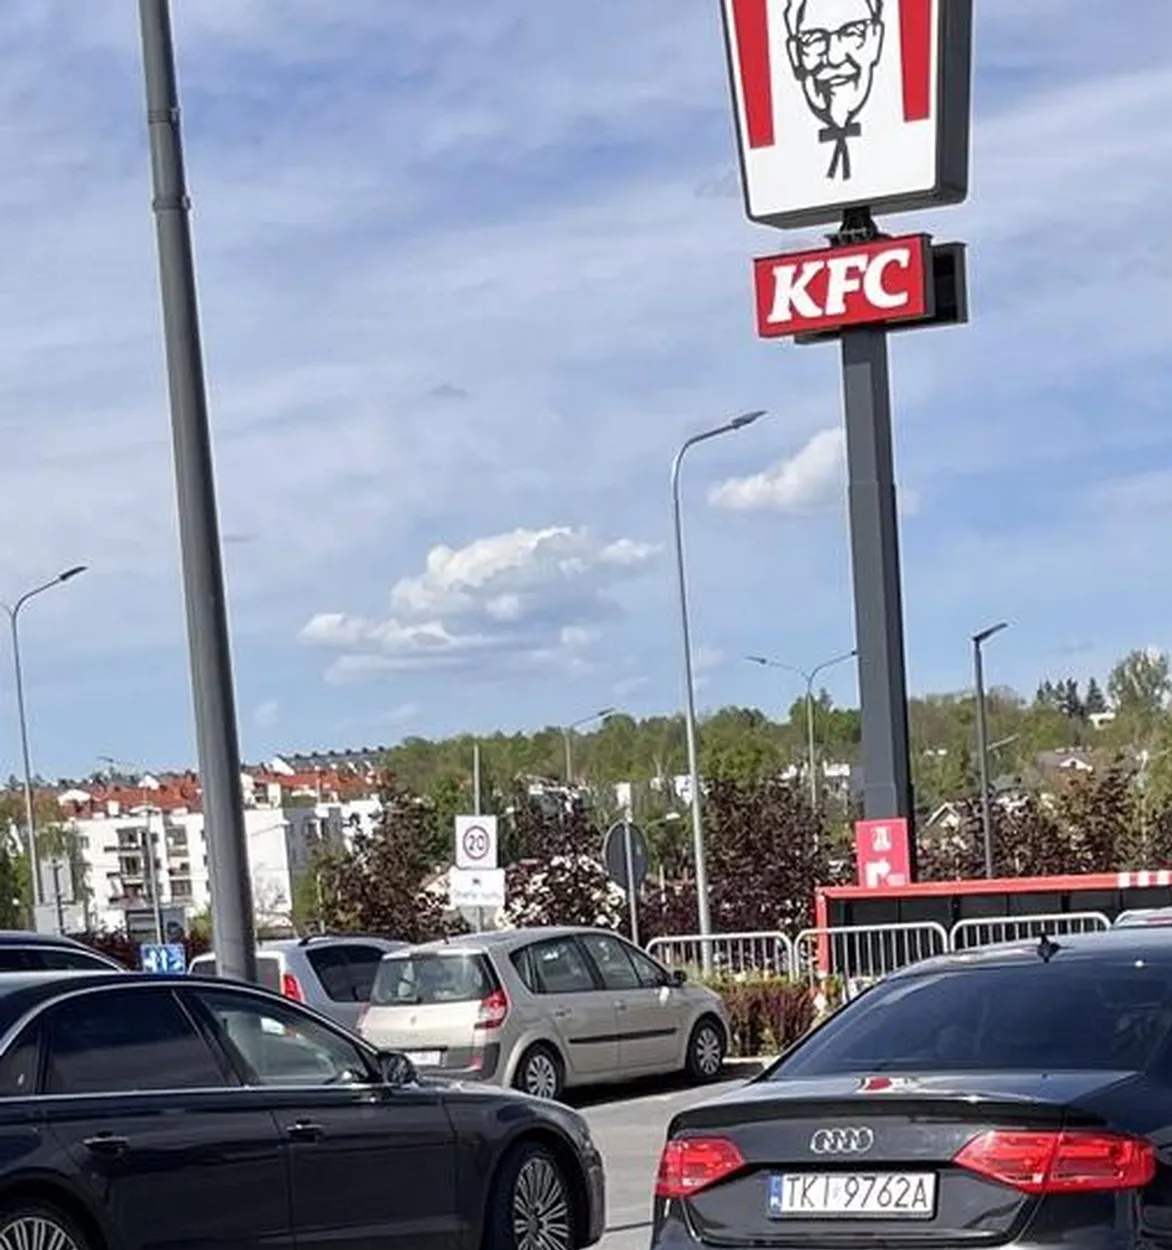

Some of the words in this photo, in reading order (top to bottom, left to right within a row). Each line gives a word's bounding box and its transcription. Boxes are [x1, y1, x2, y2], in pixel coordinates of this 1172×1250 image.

[767, 249, 910, 323] KFC
[786, 1176, 830, 1208] TKI
[843, 1176, 928, 1208] 9762A
